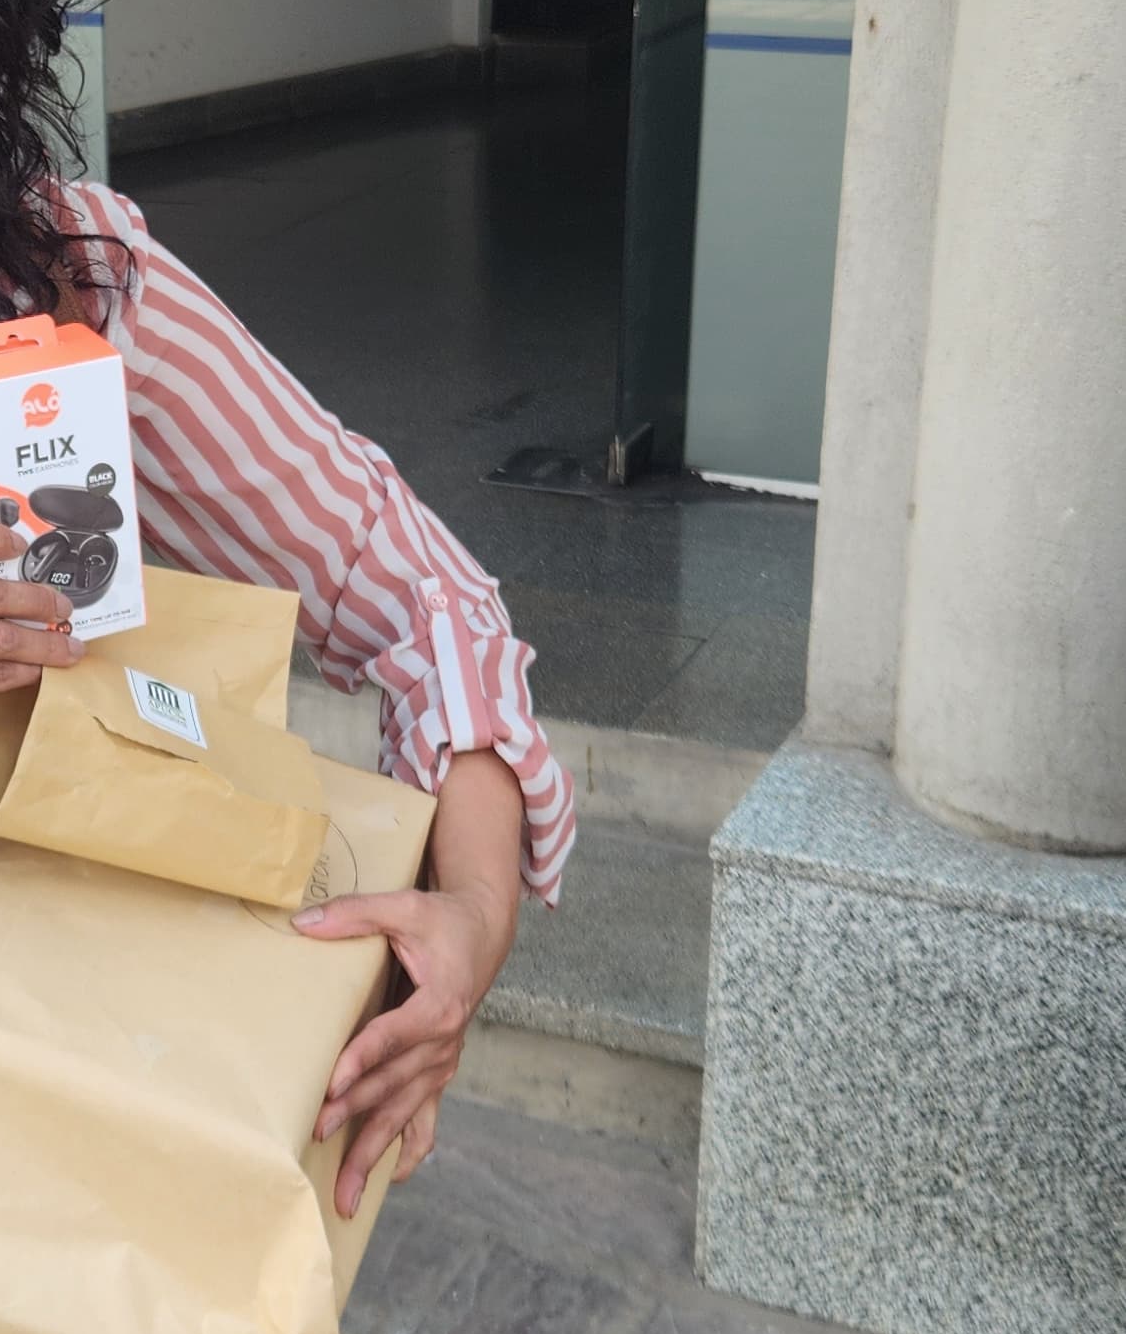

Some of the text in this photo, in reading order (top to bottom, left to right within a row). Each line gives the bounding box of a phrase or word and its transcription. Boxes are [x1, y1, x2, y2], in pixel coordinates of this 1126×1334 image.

[15, 434, 77, 468] FLIX
[88, 471, 114, 484] BLACK
[50, 572, 71, 585] 100
